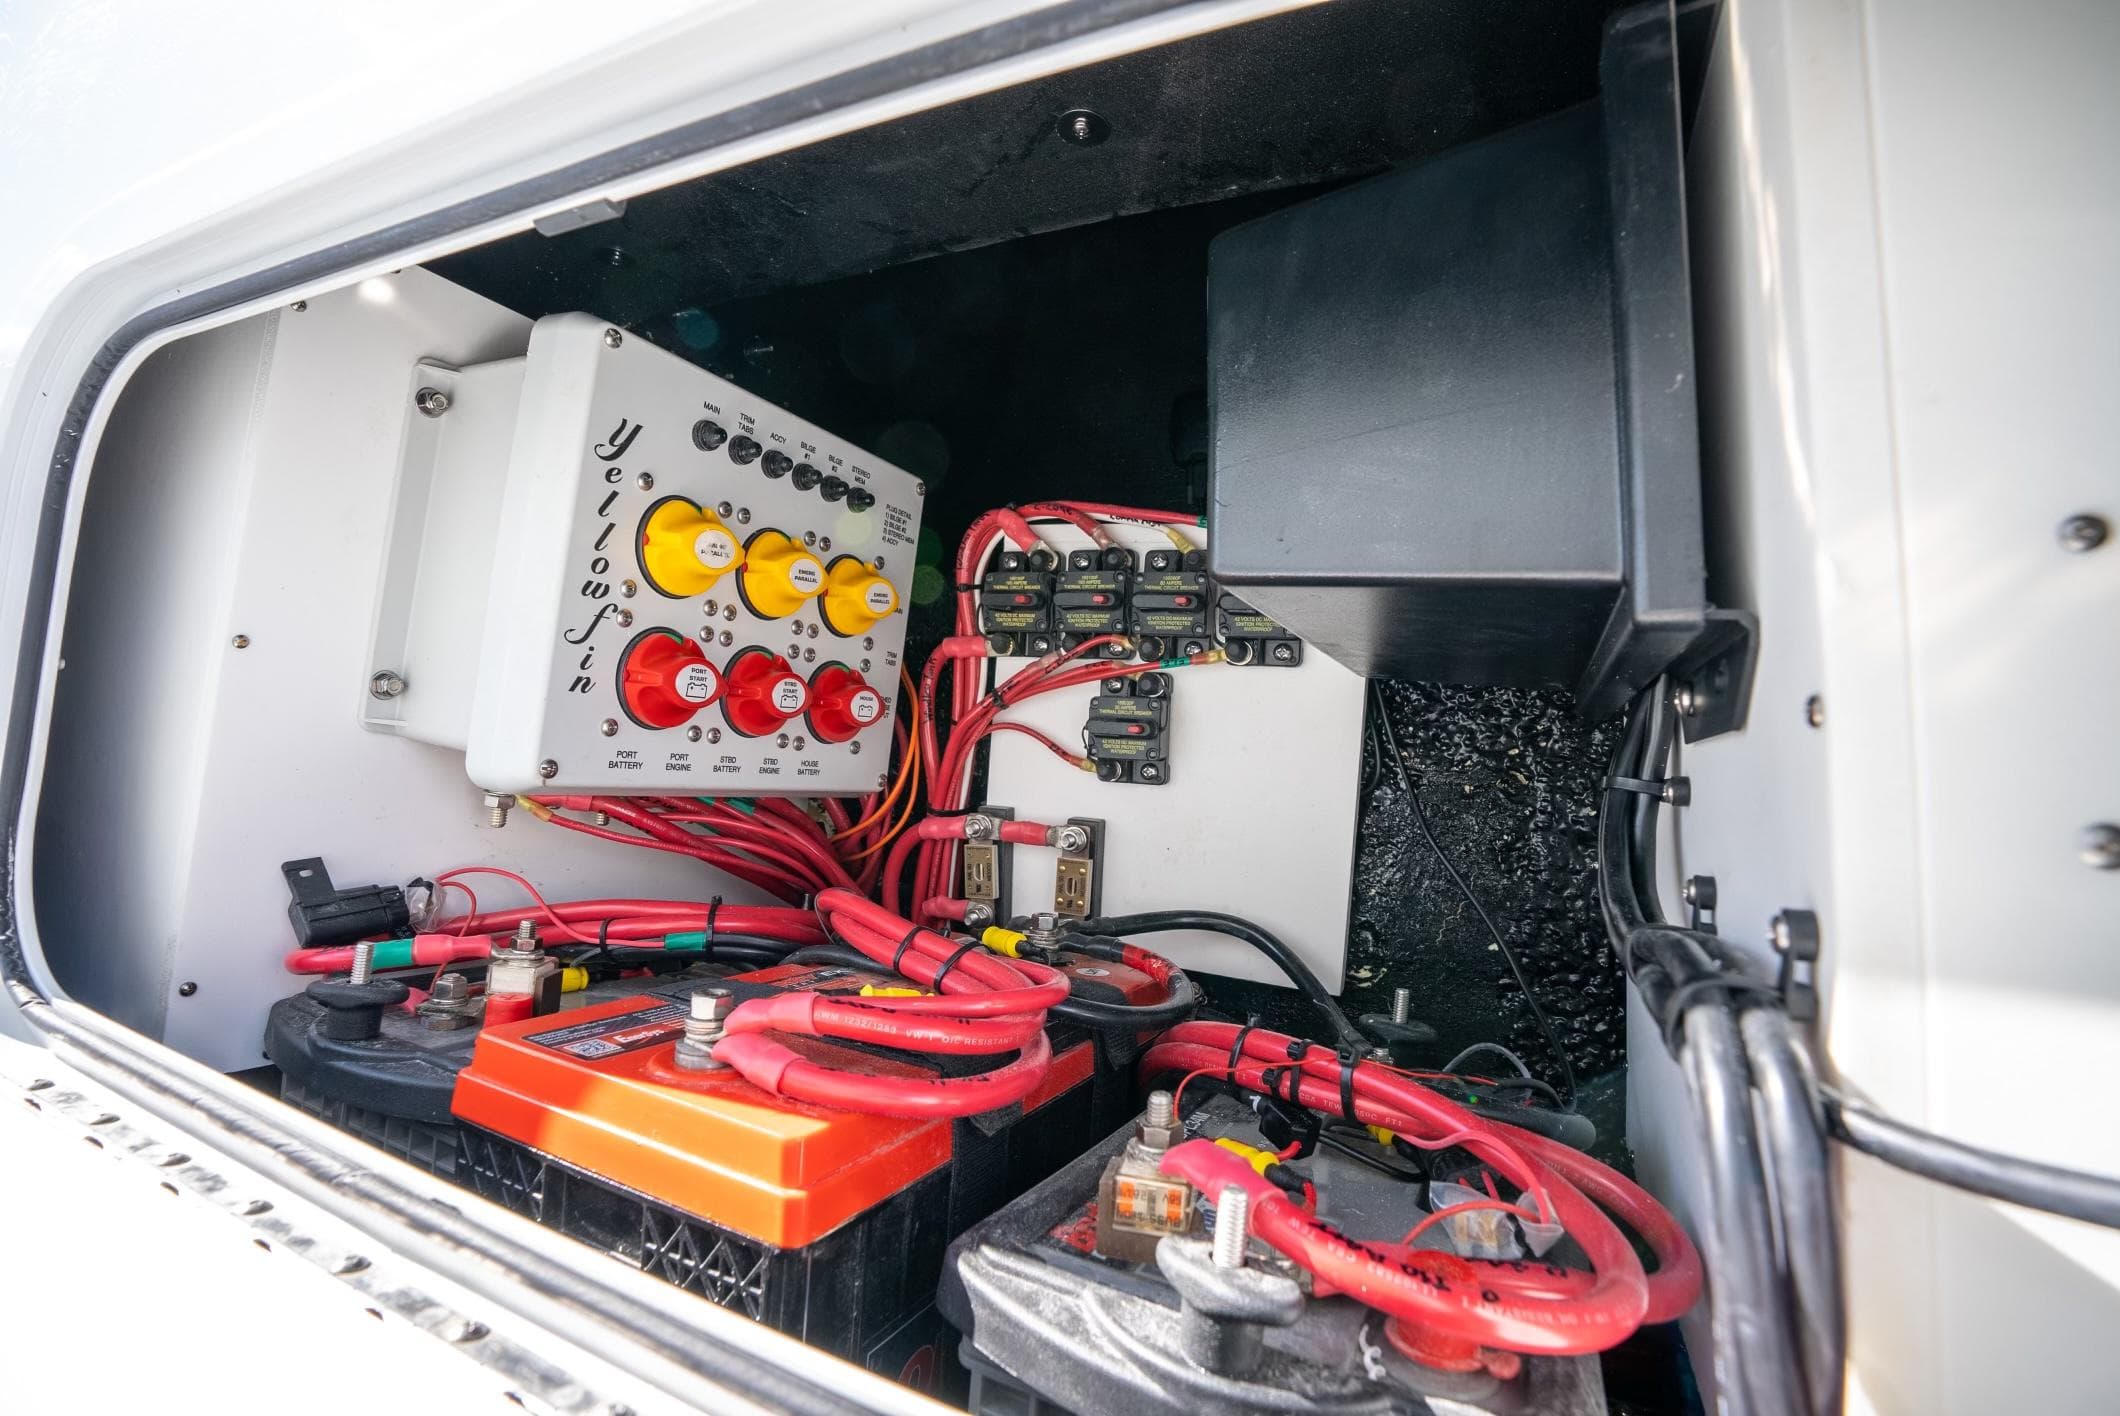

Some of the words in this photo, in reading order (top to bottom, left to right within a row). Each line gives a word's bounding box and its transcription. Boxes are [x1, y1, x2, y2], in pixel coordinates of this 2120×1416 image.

[704, 401, 720, 415] MAIN
[740, 413, 755, 425] TRIM
[738, 422, 754, 435] TABS
[770, 433, 786, 444] ACCY
[801, 441, 816, 454] BILGE
[829, 455, 843, 466] BILGE
[852, 466, 870, 479] STEREO
[855, 476, 866, 486] MEM
[617, 750, 638, 759] PORT
[670, 753, 689, 761] PORT
[608, 760, 643, 770] BATTERY
[720, 756, 736, 764] STBD
[665, 763, 691, 772] ENGINE
[713, 765, 741, 773] BATTERY
[797, 768, 820, 776] BATTERY
